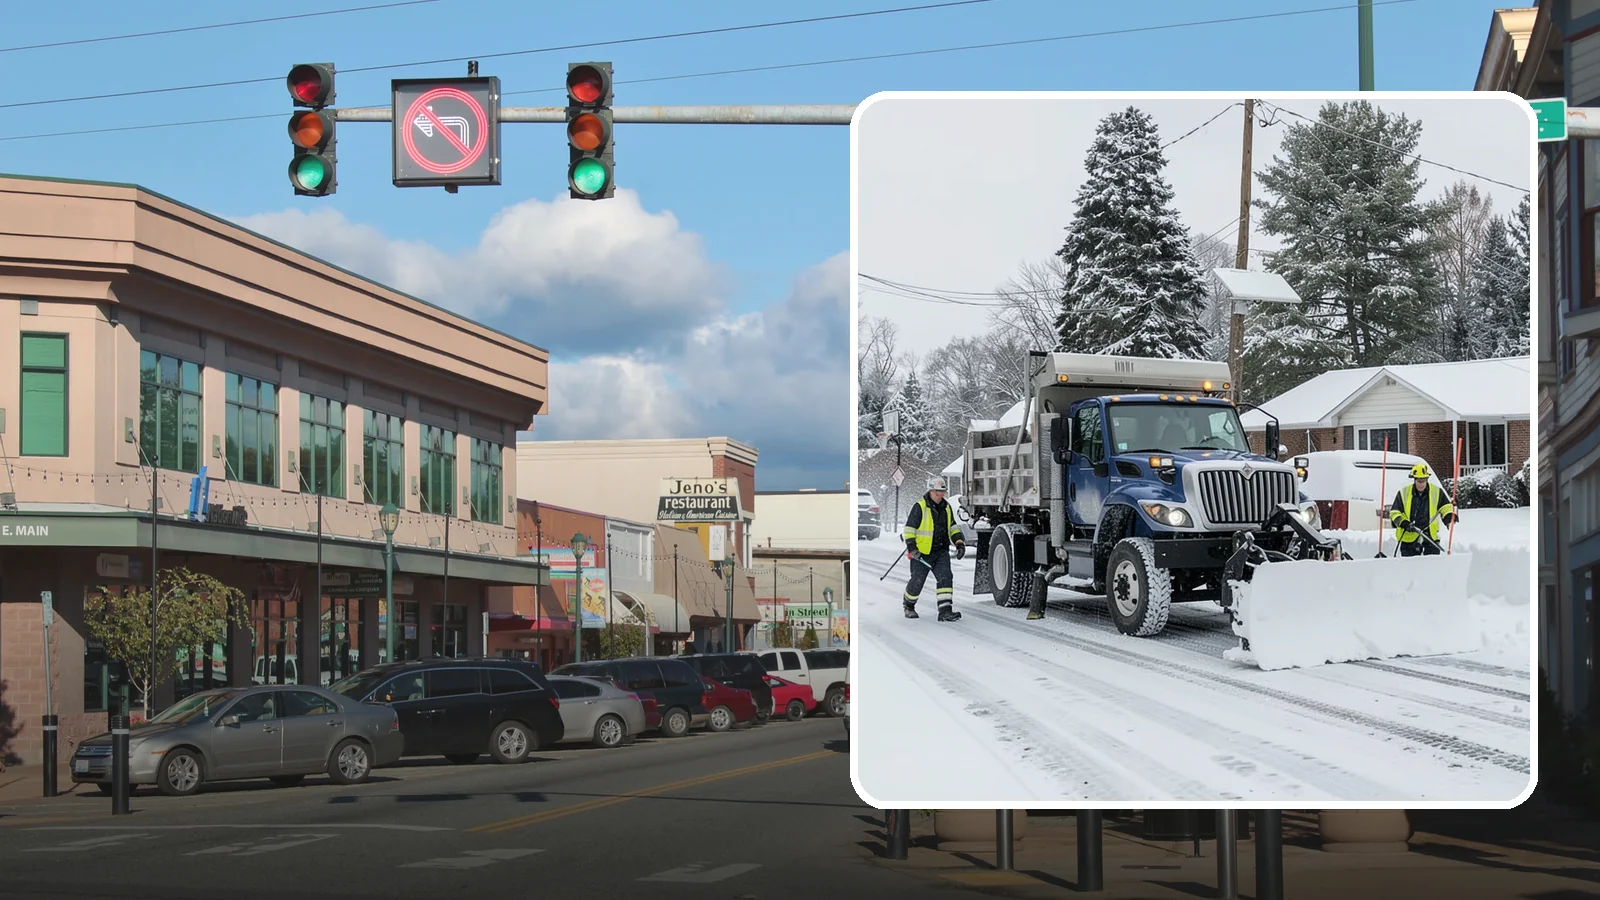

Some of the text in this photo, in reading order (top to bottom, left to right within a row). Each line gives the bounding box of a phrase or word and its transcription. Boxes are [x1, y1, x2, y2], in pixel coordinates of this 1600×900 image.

[670, 480, 728, 495] Jeno's
[665, 496, 731, 509] restaurant
[658, 510, 681, 520] Italian
[686, 509, 715, 519] American
[715, 509, 738, 519] Cuisine
[2, 525, 49, 536] E. MAIN
[797, 607, 828, 617] Street
